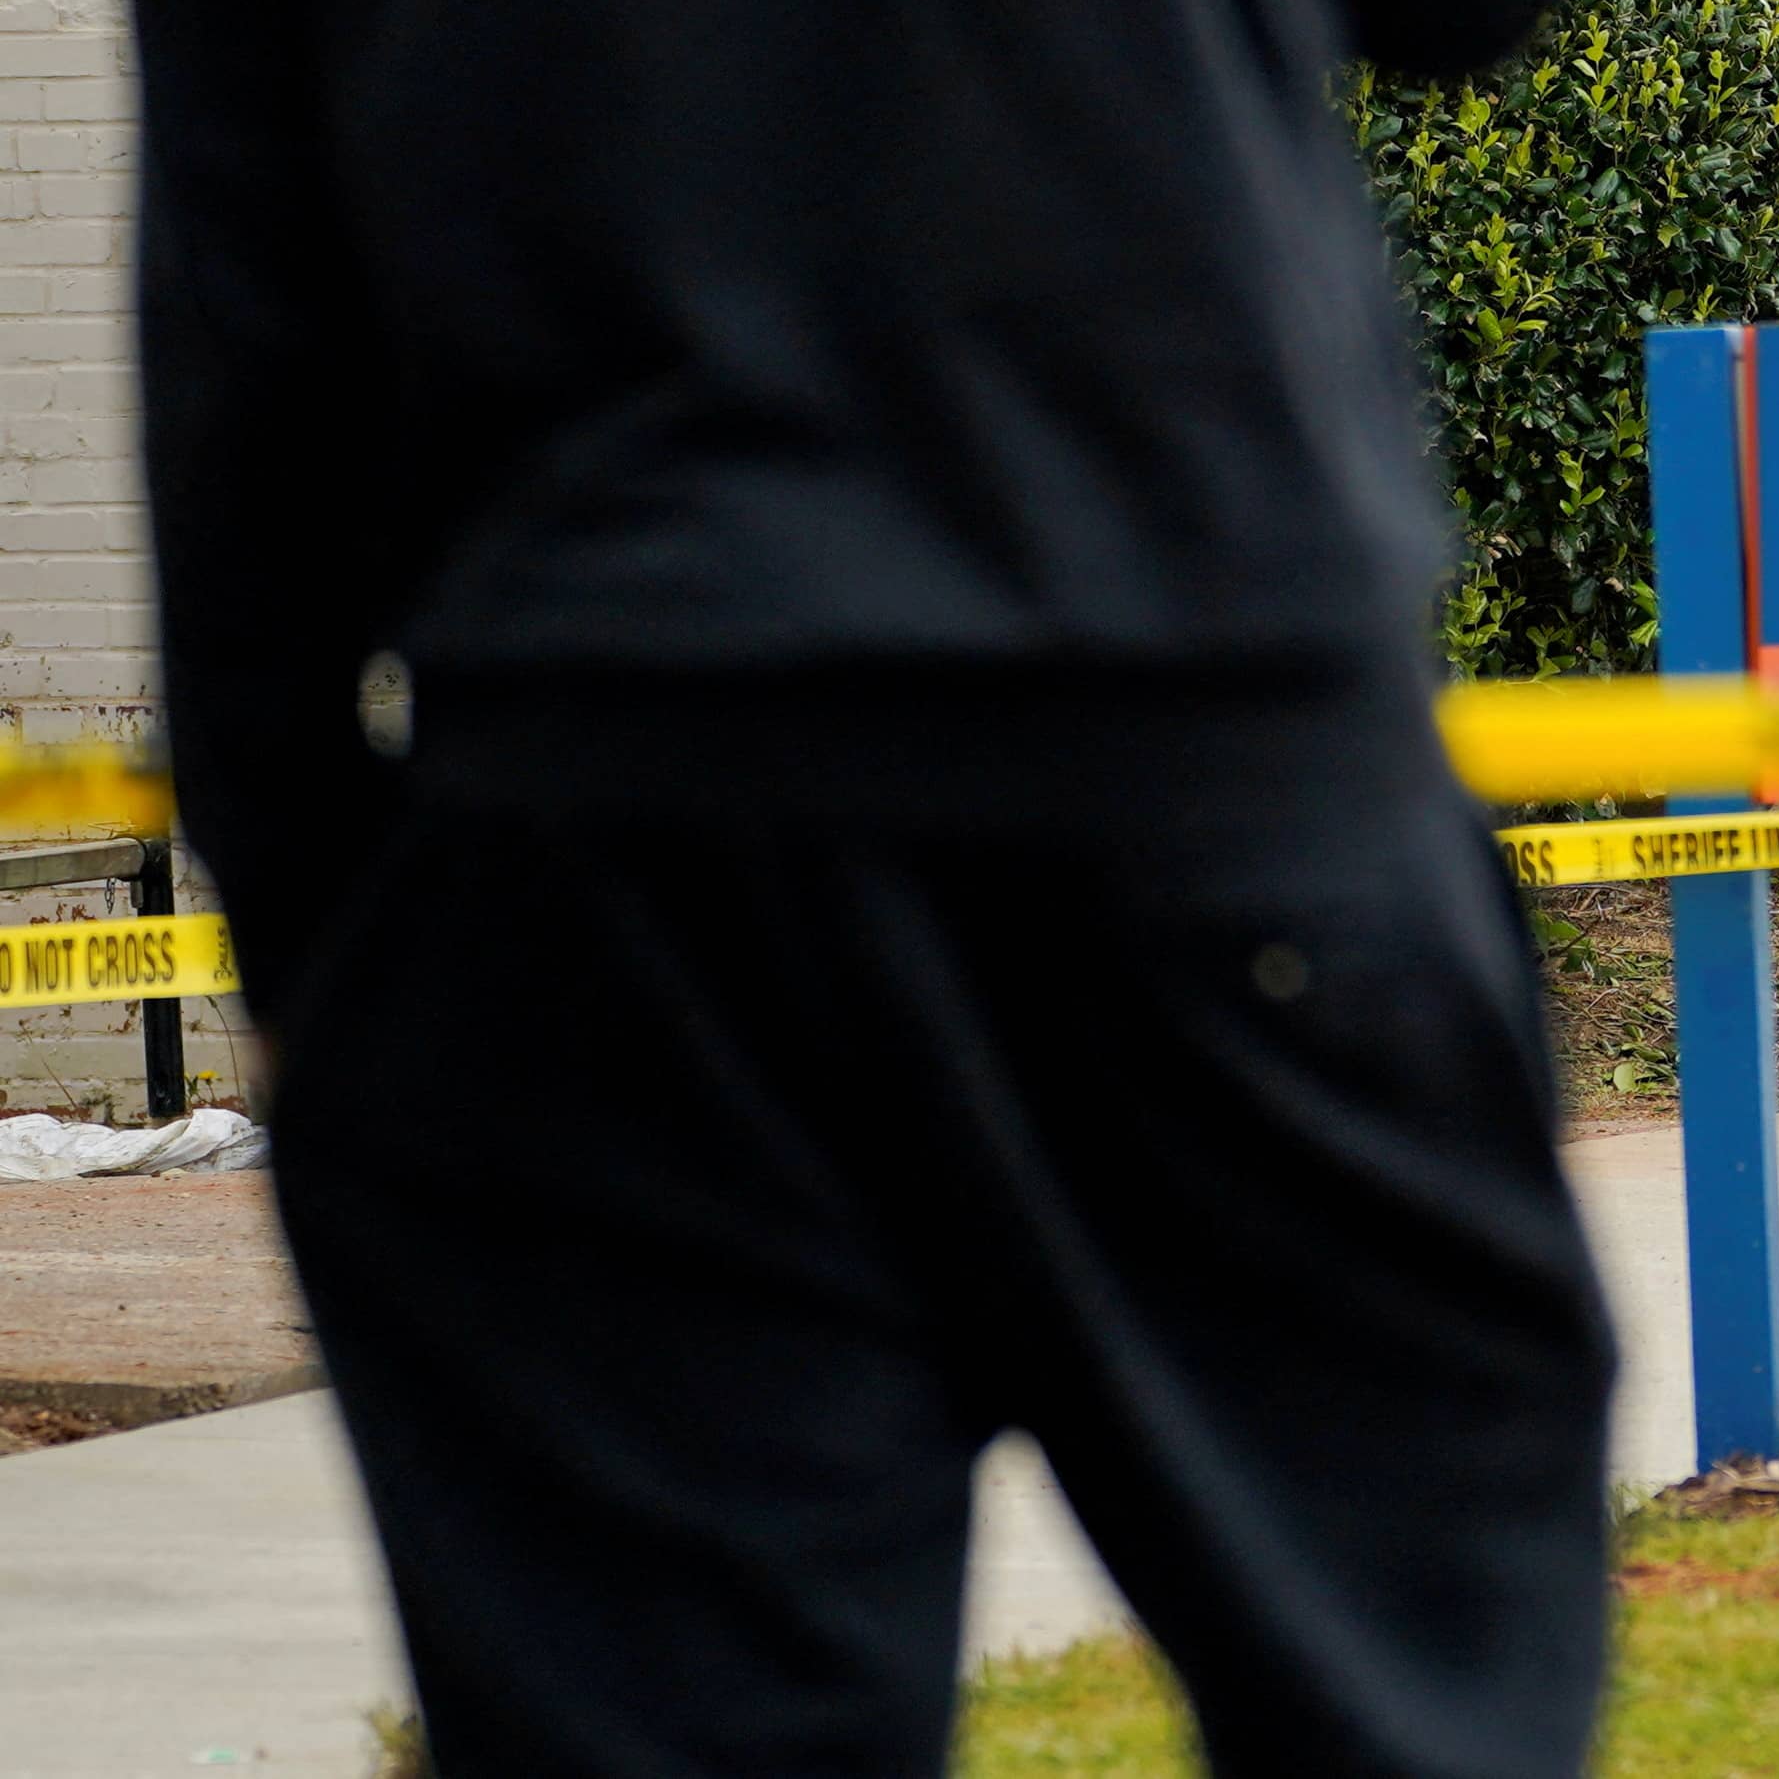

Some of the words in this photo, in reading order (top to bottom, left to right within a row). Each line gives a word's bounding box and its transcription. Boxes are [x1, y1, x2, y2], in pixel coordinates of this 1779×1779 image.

[1632, 833, 1741, 876] SHERIFF
[25, 937, 74, 994] NOT
[86, 929, 176, 988] CROSS
